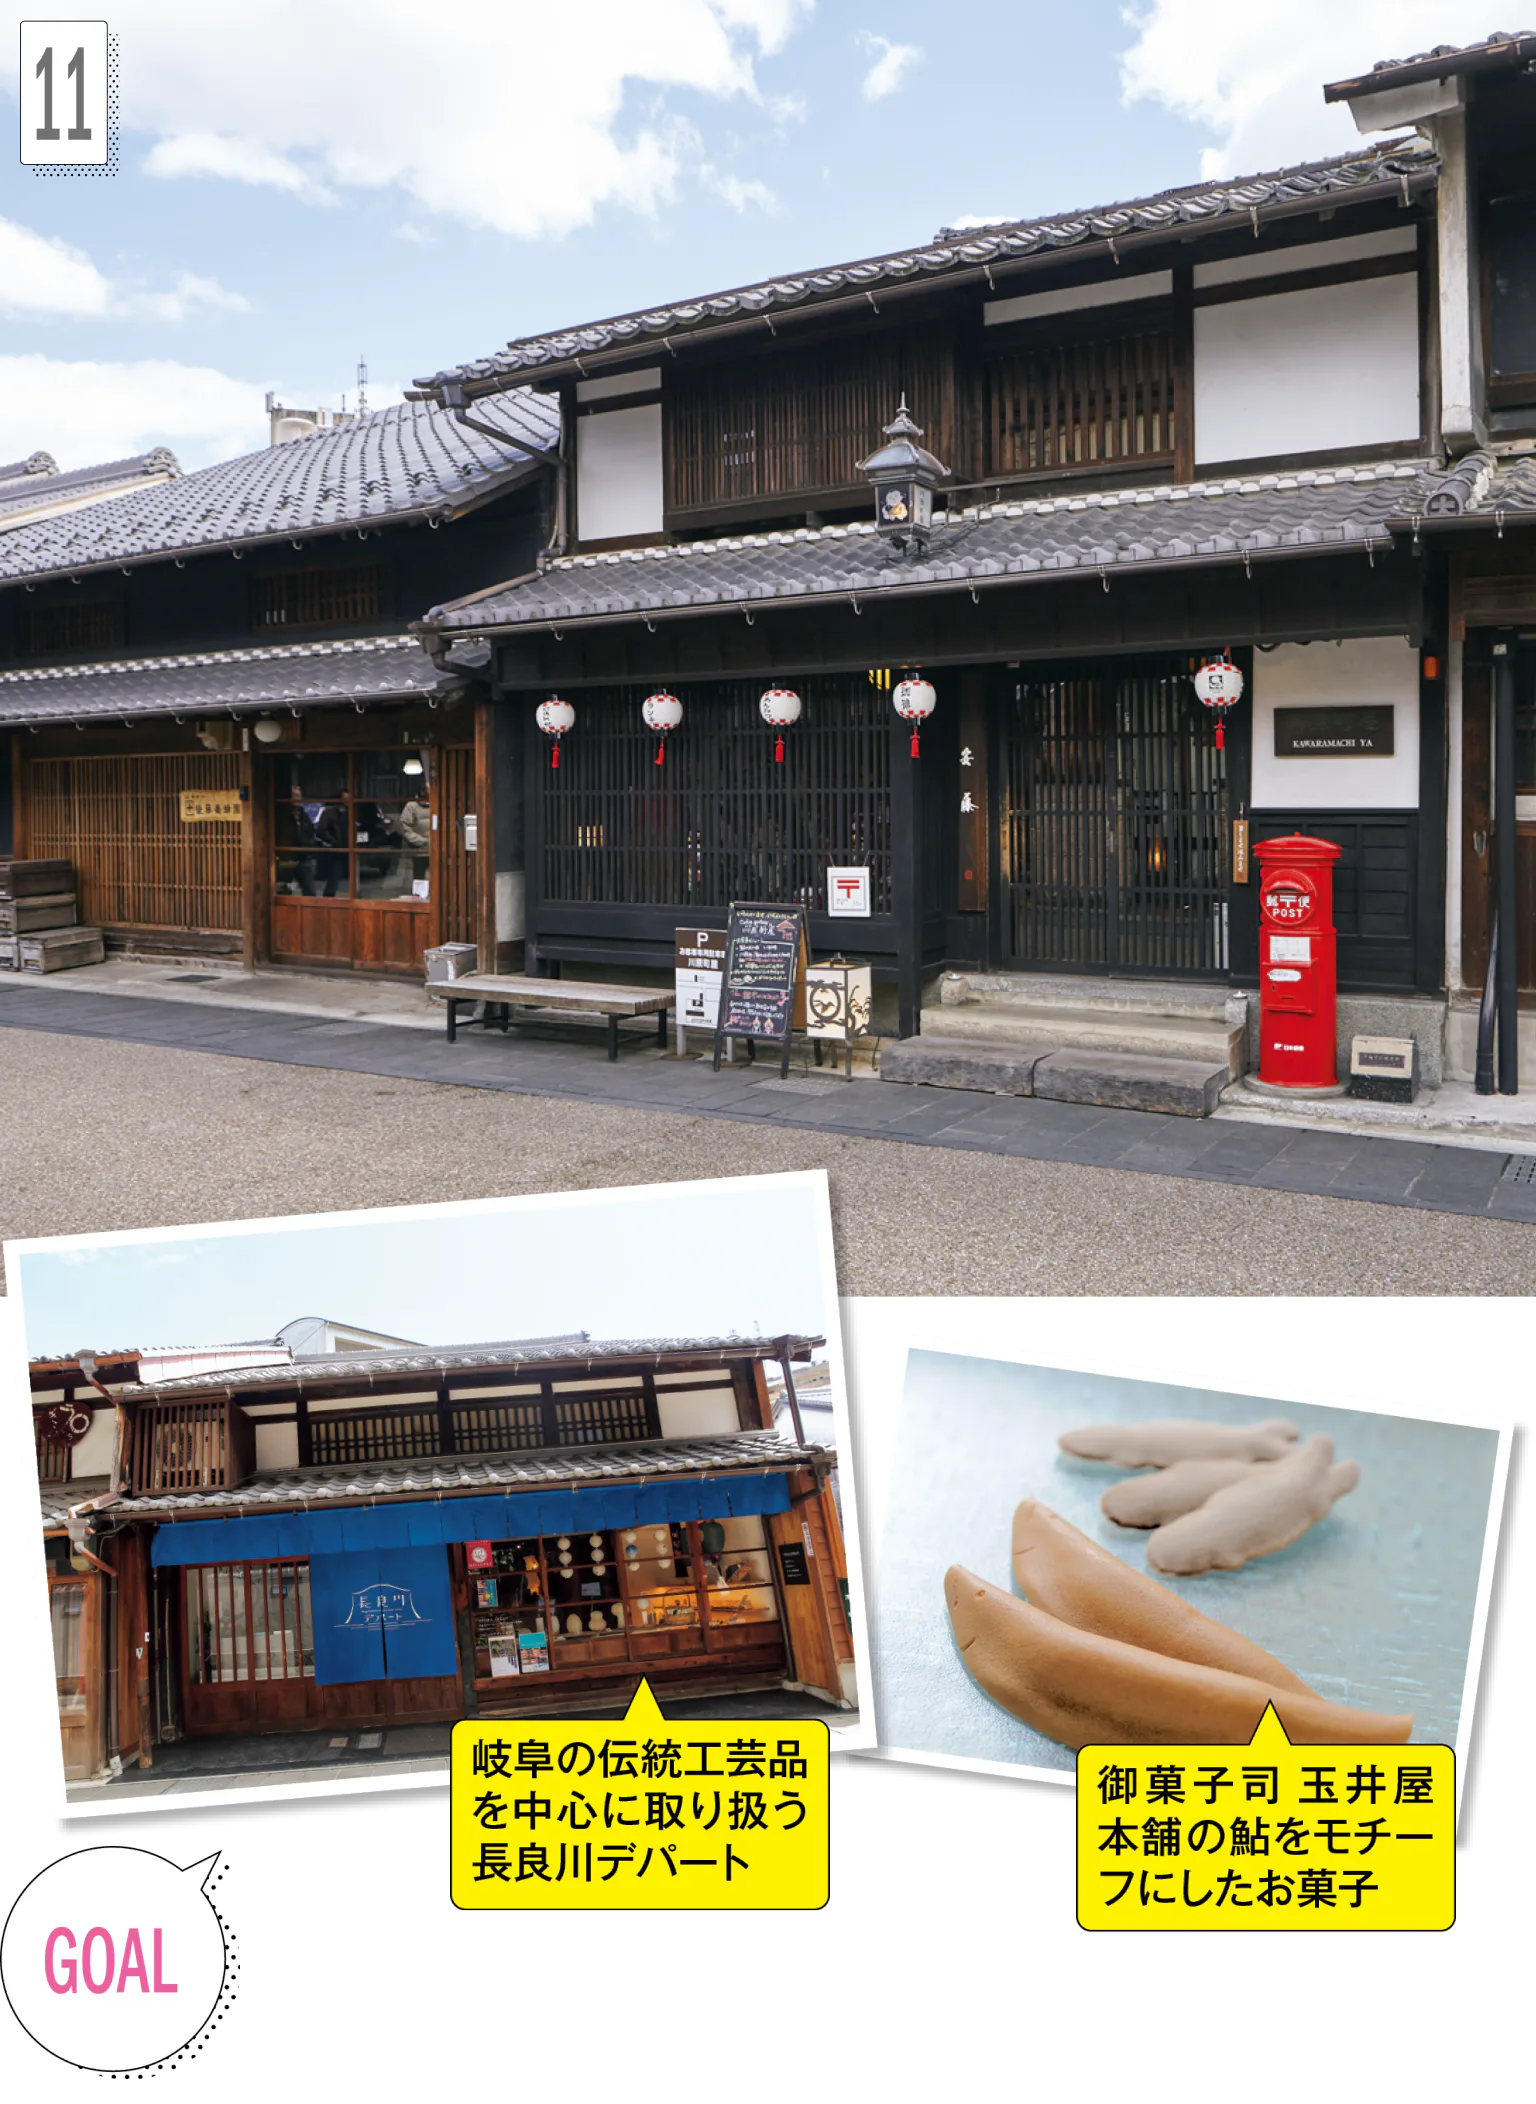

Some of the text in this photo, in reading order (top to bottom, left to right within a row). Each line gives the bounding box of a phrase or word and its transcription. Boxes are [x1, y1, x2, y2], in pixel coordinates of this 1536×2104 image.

[1293, 738, 1373, 748] KAWARAMACHI YA
[1272, 908, 1304, 918] POST
[696, 932, 709, 947] P
[359, 1595, 405, 1609] 長良川
[364, 1612, 402, 1623] デパート
